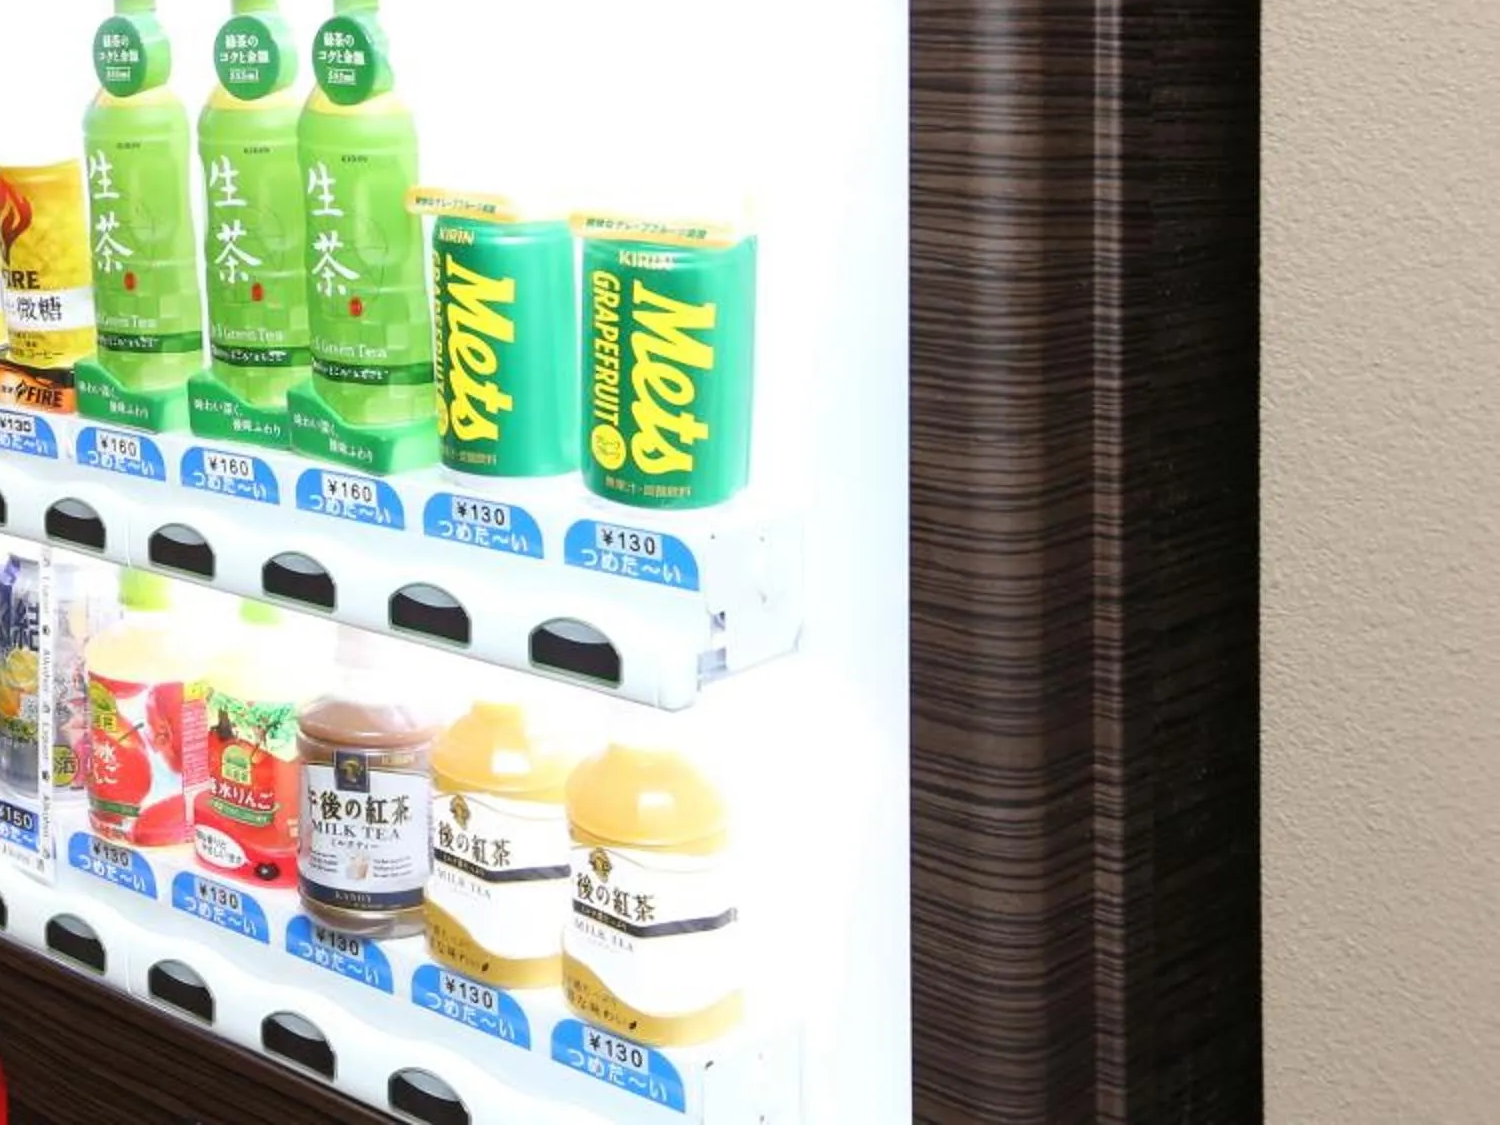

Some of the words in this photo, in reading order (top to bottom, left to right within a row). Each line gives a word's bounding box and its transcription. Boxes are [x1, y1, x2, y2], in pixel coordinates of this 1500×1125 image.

[224, 33, 259, 49] 緑茶の
[323, 32, 355, 48] 緑茶の
[89, 149, 133, 273] 生茶
[209, 154, 262, 285] 生茶
[307, 161, 361, 297] 生茶
[440, 227, 475, 247] KIRIN
[619, 250, 677, 271] KIRIN
[16, 295, 62, 322] 微糖
[259, 329, 284, 342] Tea
[447, 255, 515, 440] Mets
[592, 270, 621, 426] GRAPEFRUIT
[359, 345, 388, 358] Tea
[631, 278, 717, 475] Mets
[26, 386, 64, 408] FIRE
[0, 416, 32, 433] ¥130
[101, 438, 137, 458] ¥160
[208, 457, 249, 477] ¥160
[328, 480, 373, 503] ¥160
[456, 502, 506, 527] ¥130
[602, 531, 656, 556] ¥130
[312, 819, 358, 838] MILK
[362, 826, 401, 841] TEA
[438, 820, 512, 867] 後の紅茶
[200, 884, 238, 909] ¥130
[576, 872, 656, 922] 後の紅茶
[315, 928, 360, 956] ¥130
[611, 935, 635, 953] TEA
[444, 978, 494, 1009] ¥130
[587, 1033, 644, 1068] ¥130
